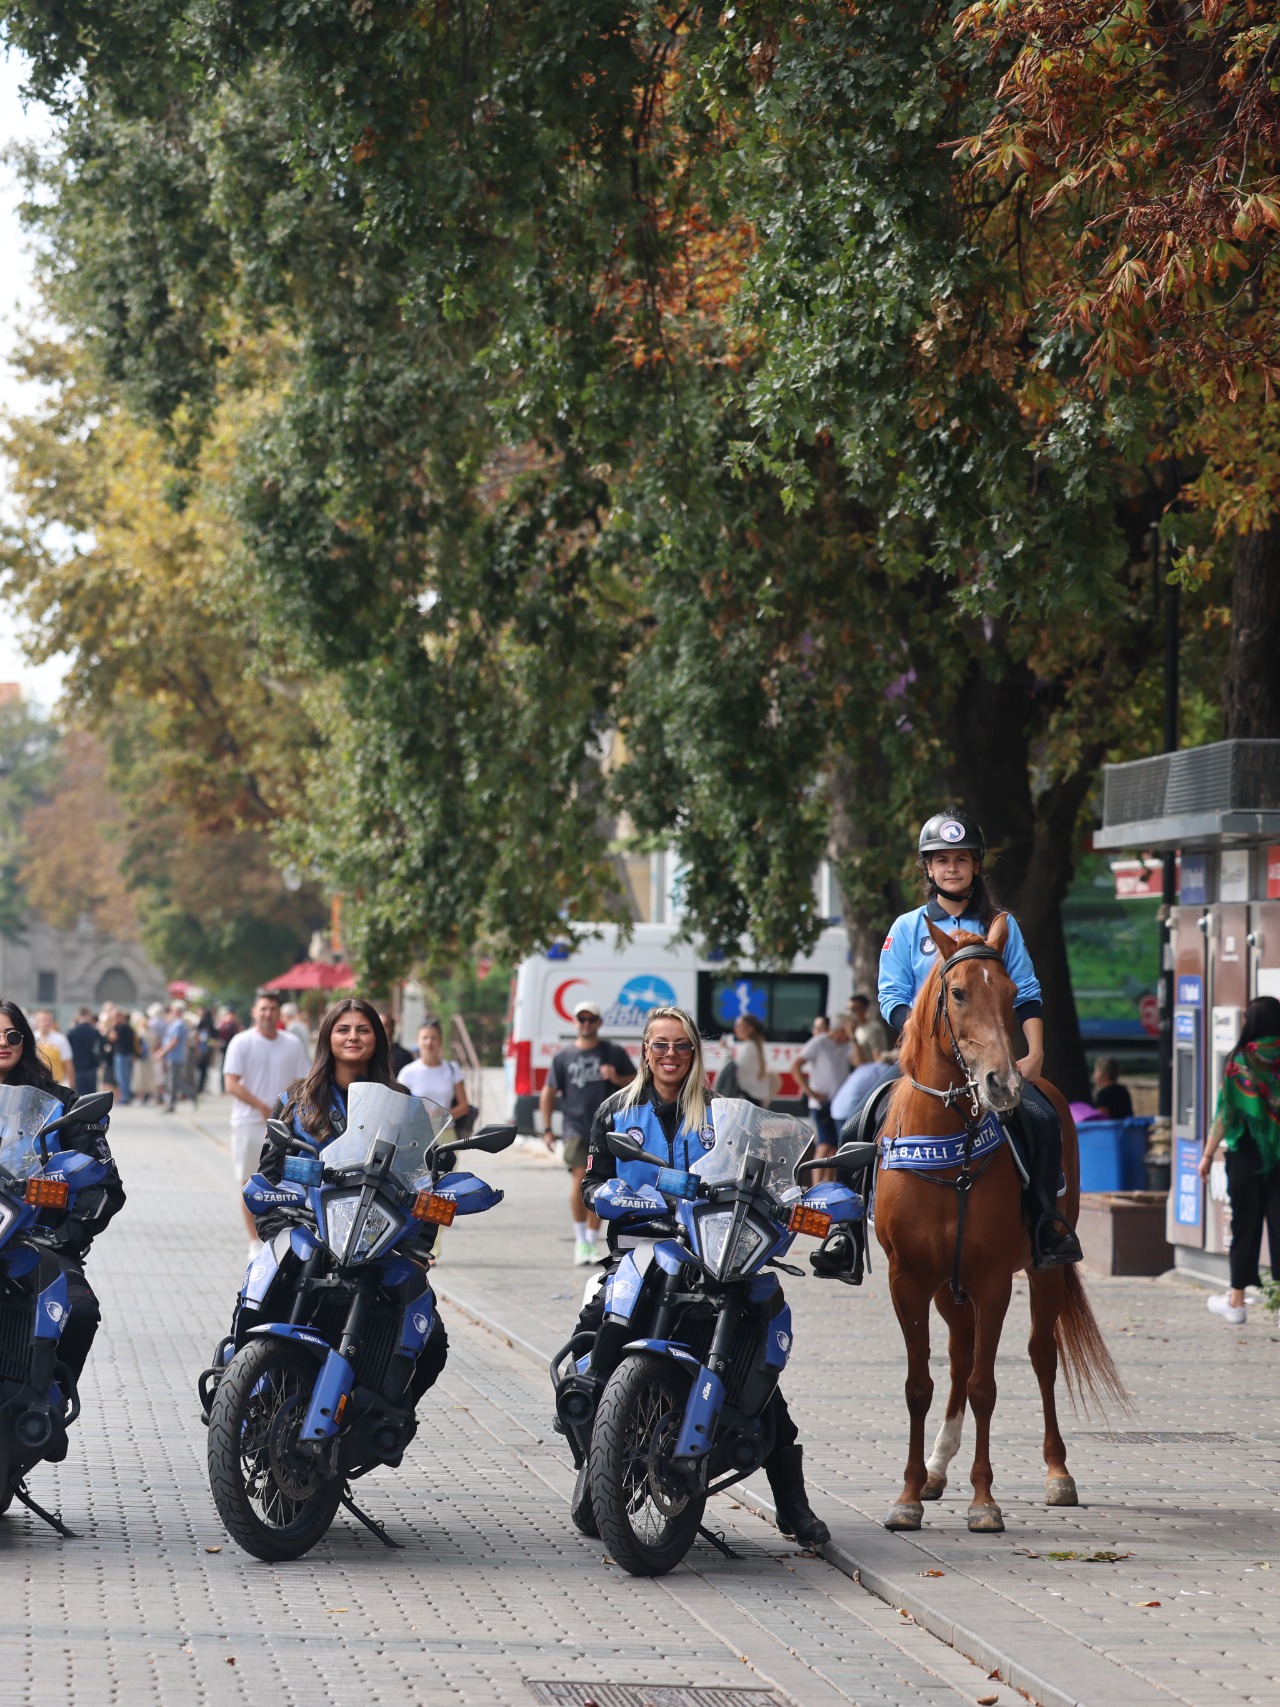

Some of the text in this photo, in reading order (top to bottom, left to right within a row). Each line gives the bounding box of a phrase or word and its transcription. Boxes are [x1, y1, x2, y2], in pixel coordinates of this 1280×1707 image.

[954, 1126, 996, 1156] ZBITA
[262, 1194, 299, 1202] ZABITA
[620, 1199, 658, 1210] ZABITA
[803, 1201, 828, 1210] BITA
[702, 1382, 712, 1401] KTM
